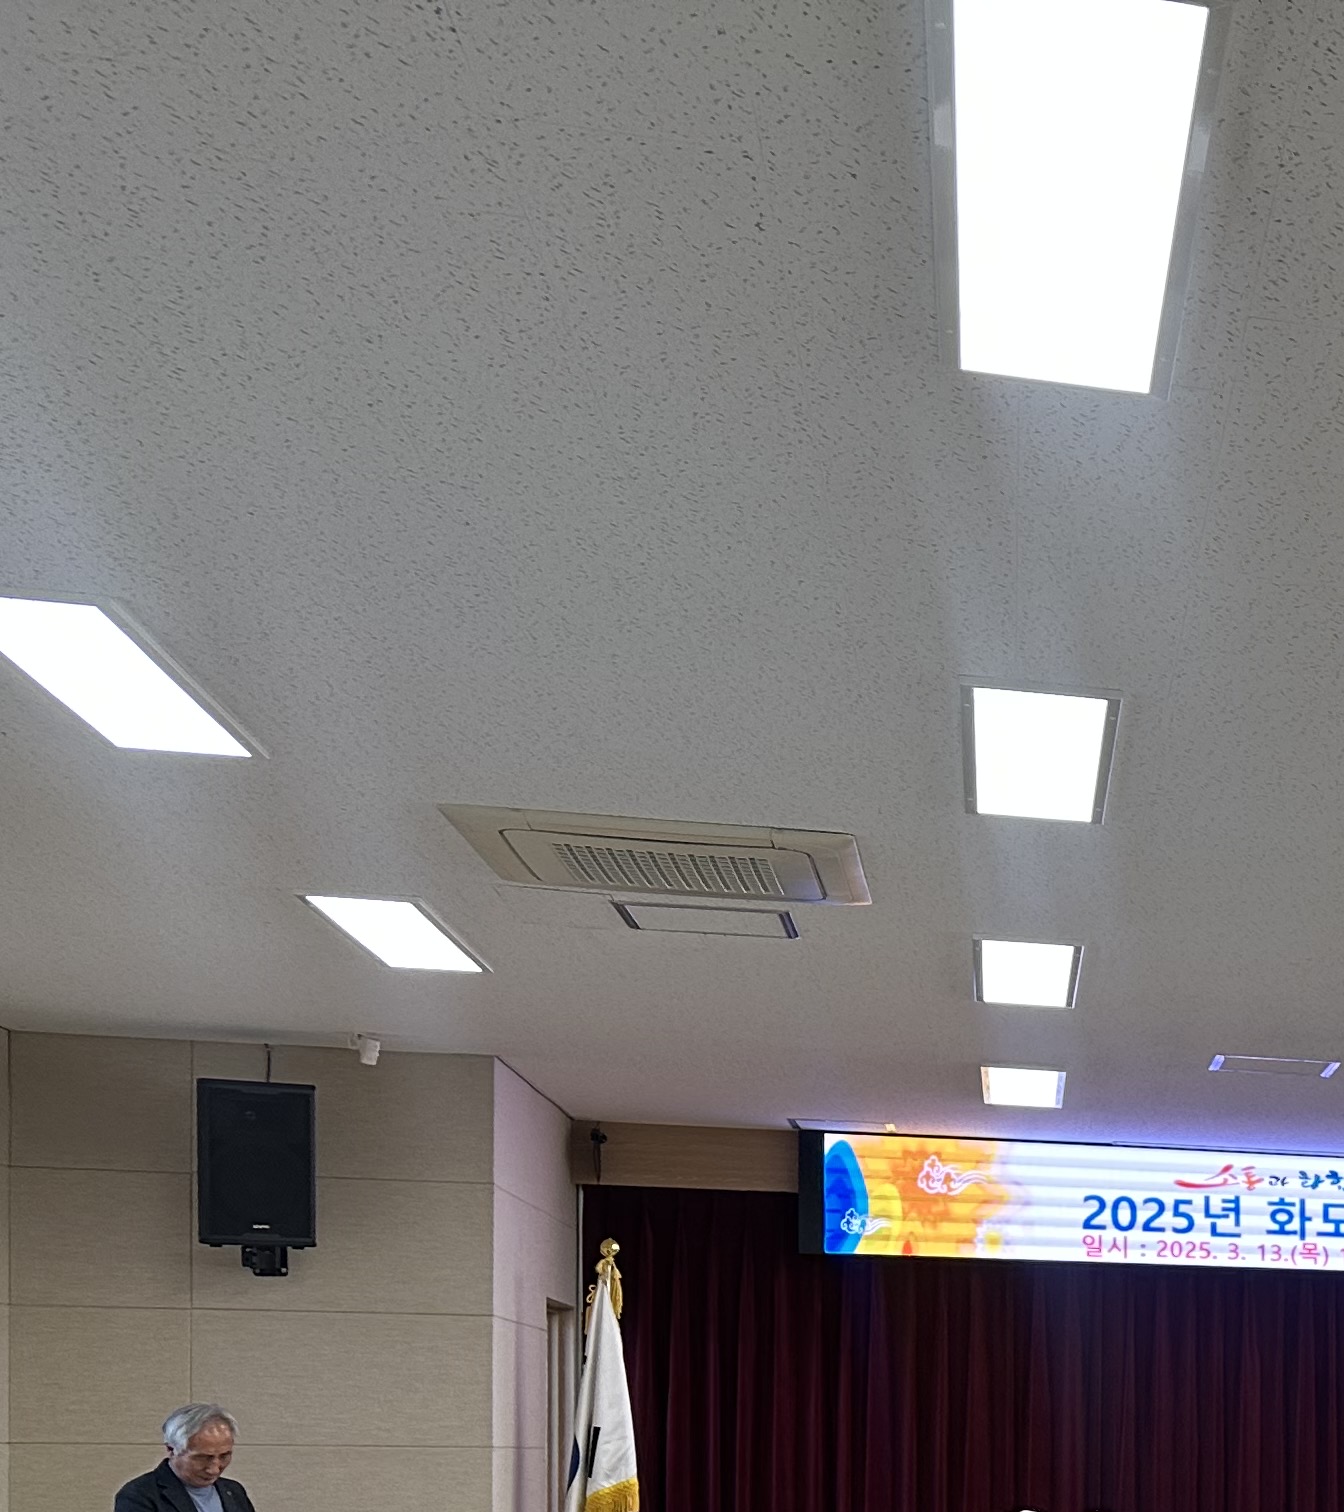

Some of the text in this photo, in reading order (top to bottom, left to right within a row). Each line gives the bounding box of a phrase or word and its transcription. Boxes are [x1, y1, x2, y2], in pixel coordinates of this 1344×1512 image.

[1174, 1163, 1288, 1191] 소통과
[1081, 1194, 1242, 1239] 2025년
[1081, 1234, 1129, 1259] 일시
[1156, 1239, 1218, 1261] 2025.
[1227, 1242, 1247, 1261] 3.
[1257, 1243, 1329, 1266] 13.(목)
